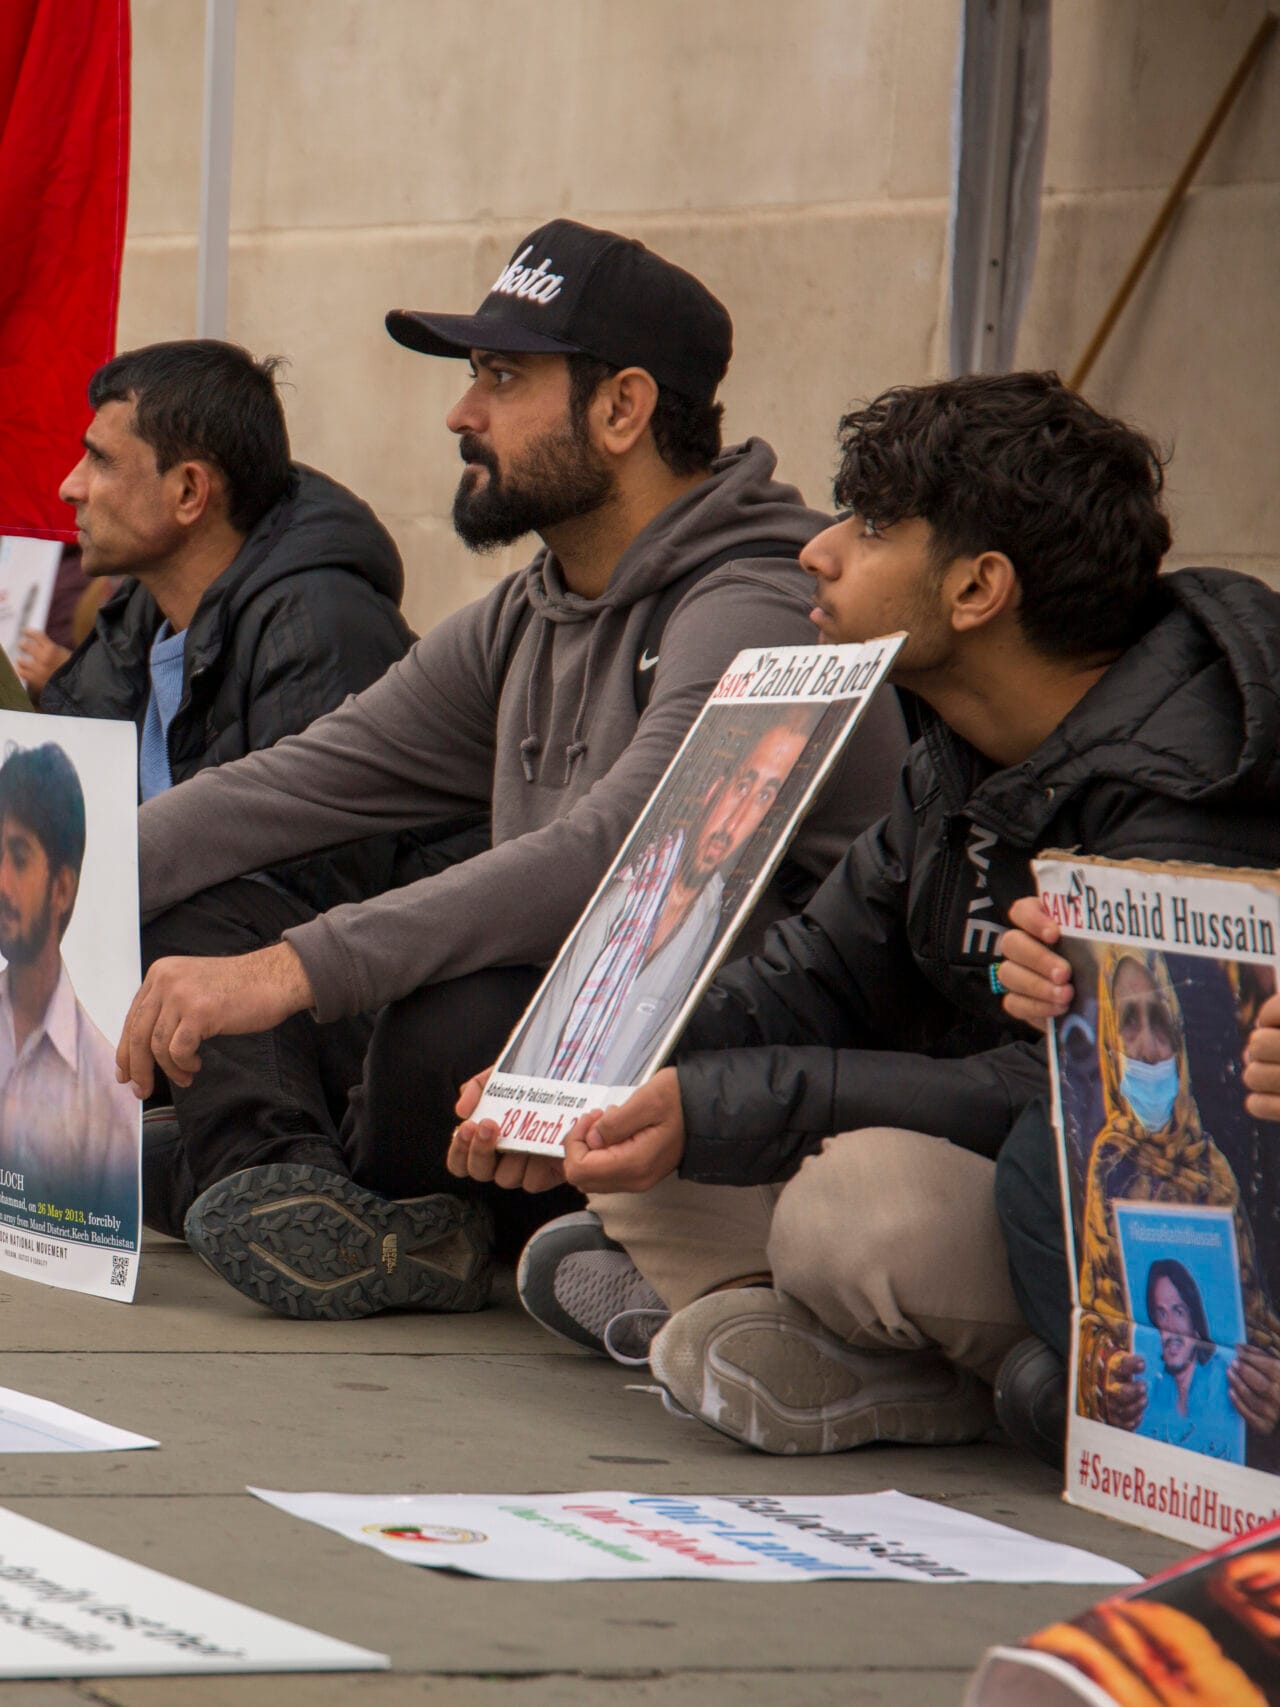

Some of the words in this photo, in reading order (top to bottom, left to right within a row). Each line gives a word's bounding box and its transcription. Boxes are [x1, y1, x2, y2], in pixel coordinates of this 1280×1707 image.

[749, 654, 821, 698] Zahid
[807, 647, 885, 696] Baoch
[1085, 885, 1166, 940] Rashid
[1173, 896, 1277, 956] Hussain
[486, 1081, 517, 1100] Abducted
[516, 1086, 527, 1104] by
[555, 1091, 578, 1108] Forces
[576, 1098, 587, 1109] on
[501, 1107, 522, 1139] 18
[514, 1111, 565, 1145] March
[17, 1214, 29, 1228] from
[30, 1218, 45, 1232] Mand
[91, 1232, 134, 1249] Balochistan
[28, 1203, 36, 1213] on
[37, 1202, 46, 1215] 26
[47, 1205, 63, 1220] May
[65, 1208, 87, 1226] 2013,
[88, 1212, 121, 1232] forcibly
[10, 1232, 34, 1251] NATIONAL
[36, 1243, 68, 1259] MOVEMENT
[1079, 1450, 1277, 1538] #SaveRashidHuss
[628, 1498, 737, 1529] Our
[712, 1530, 876, 1572] Land
[712, 1496, 969, 1577] Balochistan
